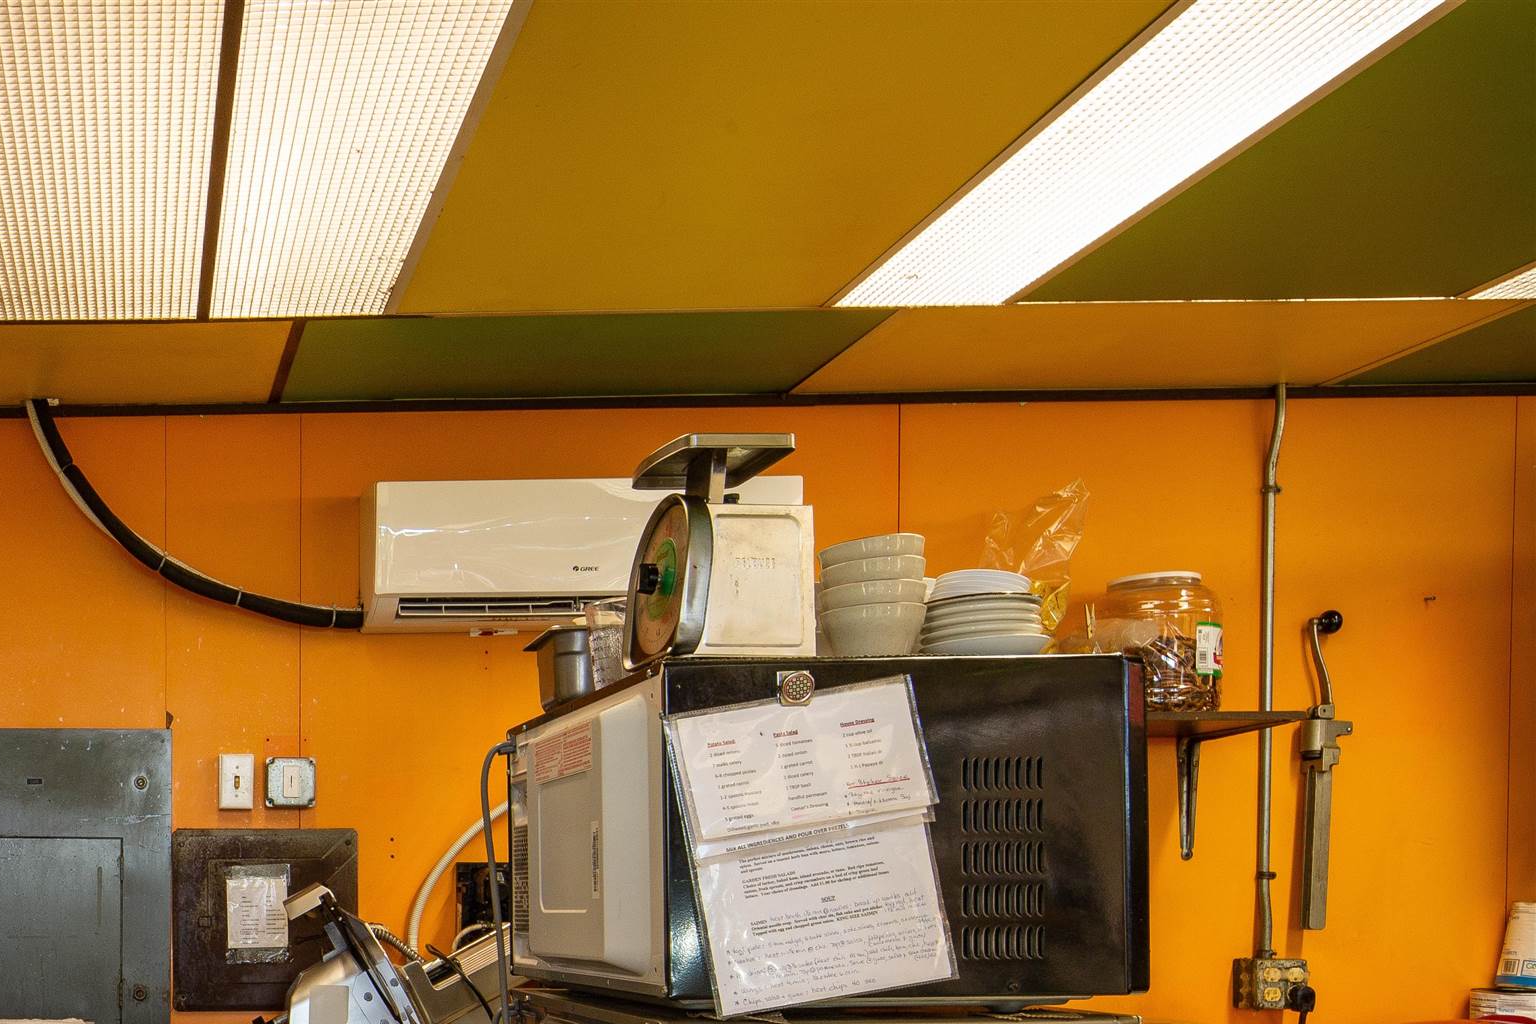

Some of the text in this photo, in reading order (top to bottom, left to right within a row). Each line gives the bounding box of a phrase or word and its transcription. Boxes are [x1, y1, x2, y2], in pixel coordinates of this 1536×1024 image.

[783, 832, 796, 840] AND
[797, 829, 812, 837] POUR
[812, 826, 826, 834] OVER
